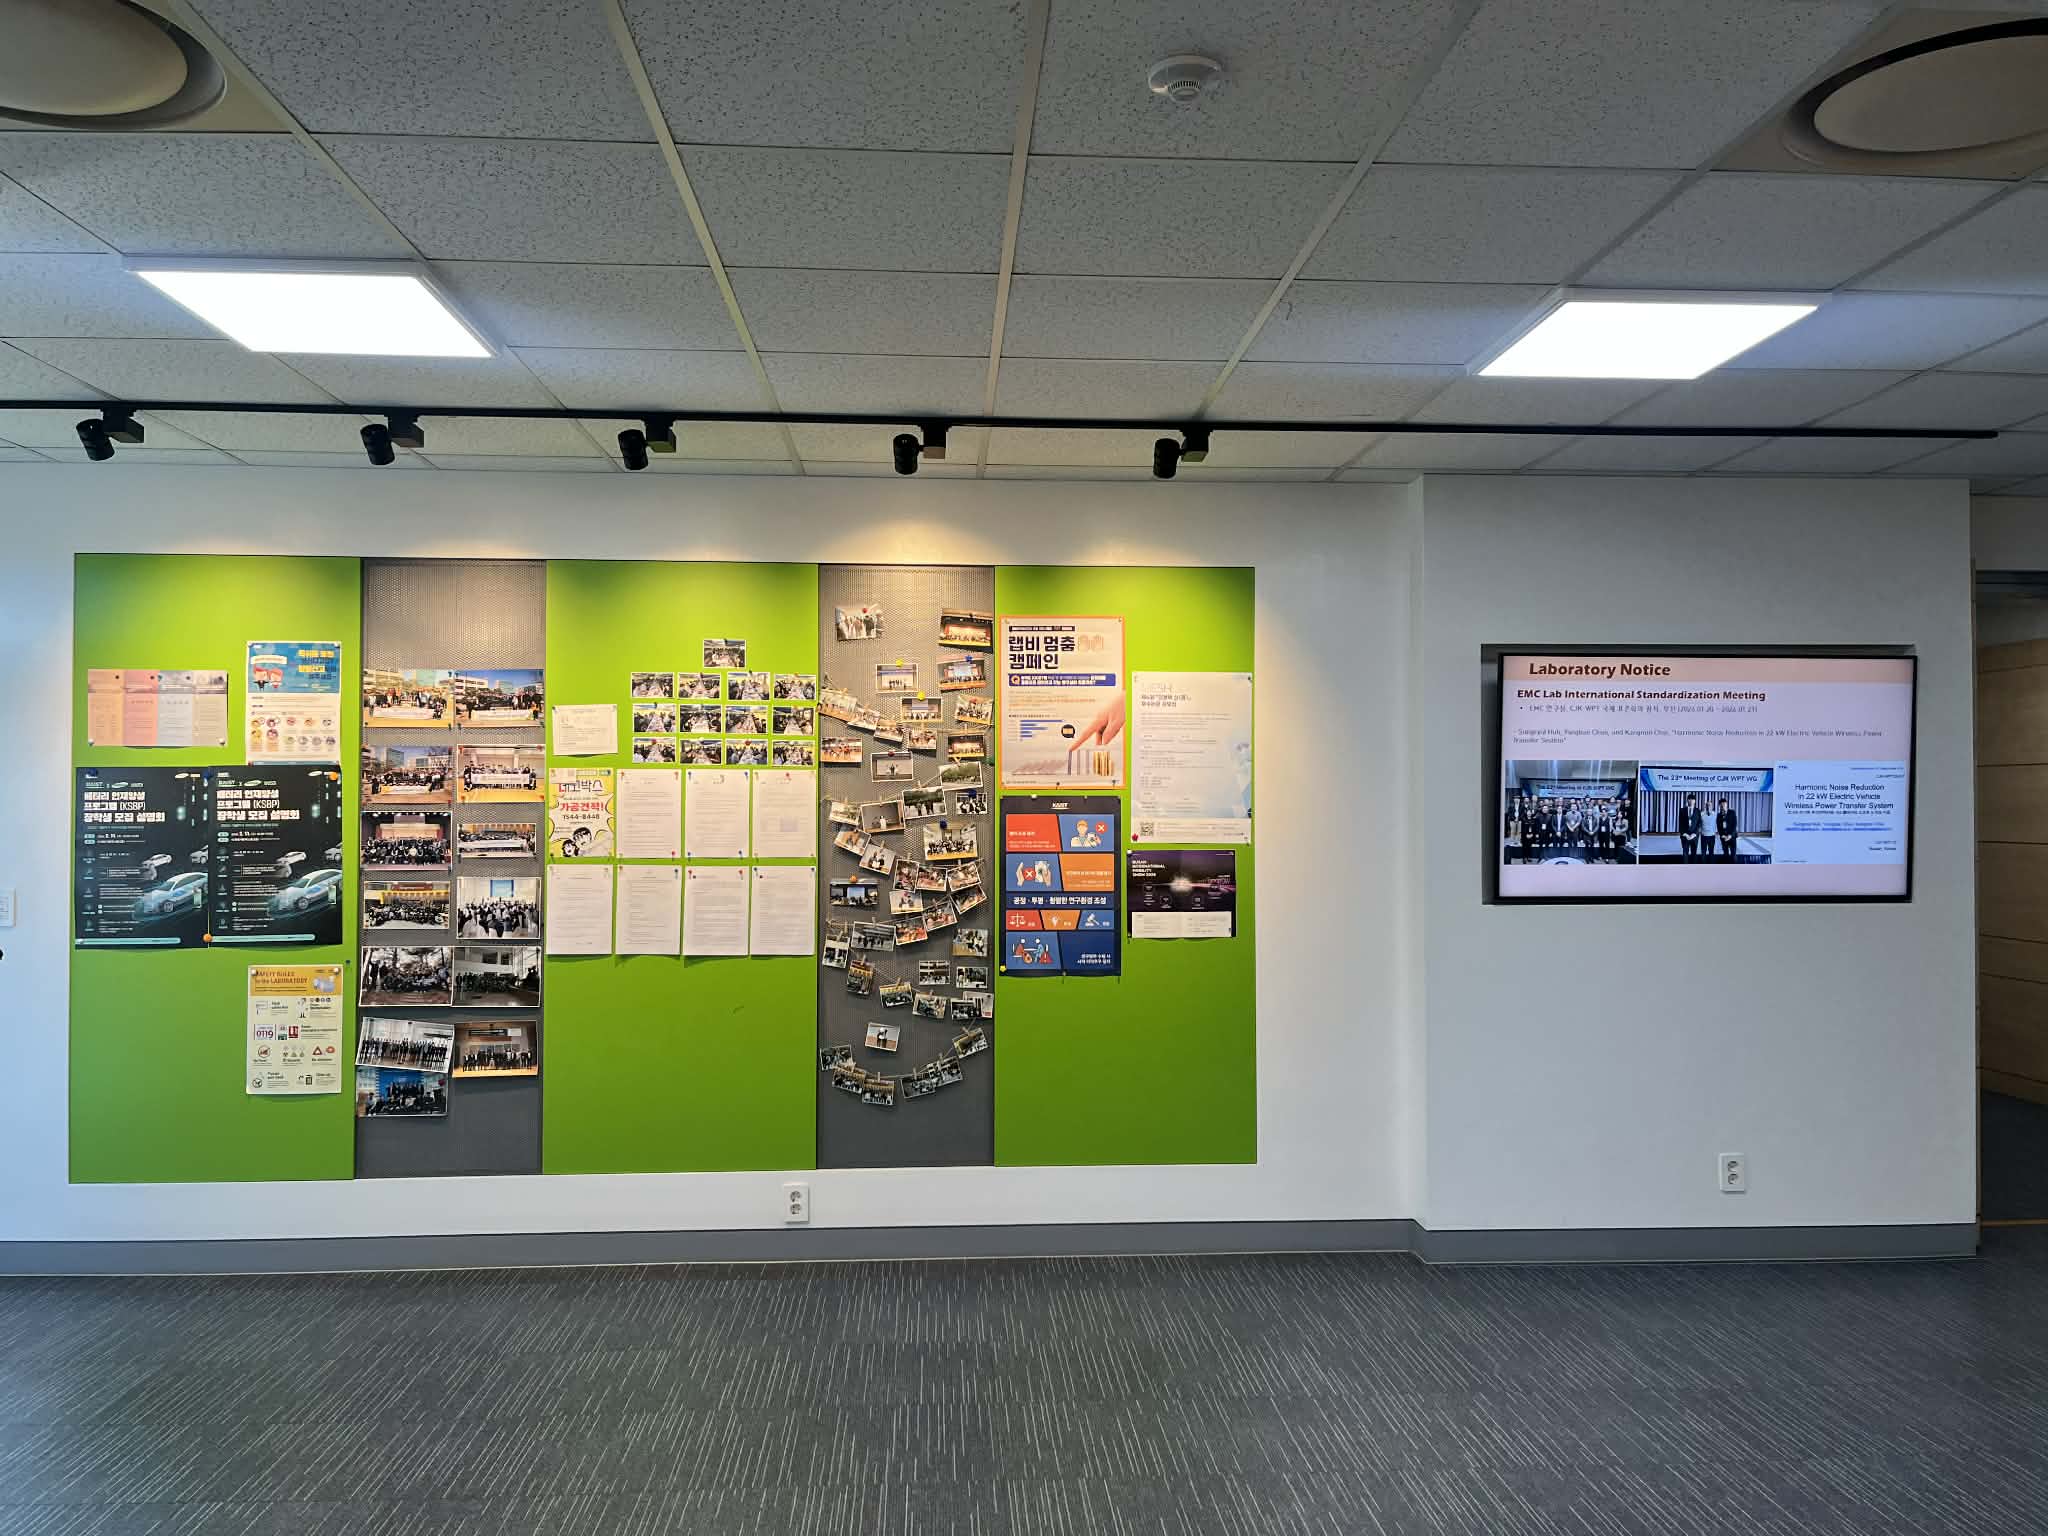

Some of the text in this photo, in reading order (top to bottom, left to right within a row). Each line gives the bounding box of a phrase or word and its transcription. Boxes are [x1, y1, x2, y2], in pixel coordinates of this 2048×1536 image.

[1008, 635, 1039, 652] 랩비
[1043, 635, 1075, 652] 멈춤
[1008, 653, 1059, 670] 캠페인
[1529, 663, 1671, 679] Laboratory Notice
[1517, 690, 1766, 702] EMC Lab International Standardization Meeting
[1684, 775, 1708, 783] Meeting
[84, 801, 146, 811] 프로그램 (KSBP)
[217, 799, 280, 810] 프로그램 (KSBP)
[560, 801, 604, 812] 가공견적!
[1868, 802, 1894, 811] System
[84, 811, 166, 823] 장학생 모집 설명회
[217, 809, 300, 821] 장학생 모집 설명회
[256, 1030, 274, 1039] 0119
